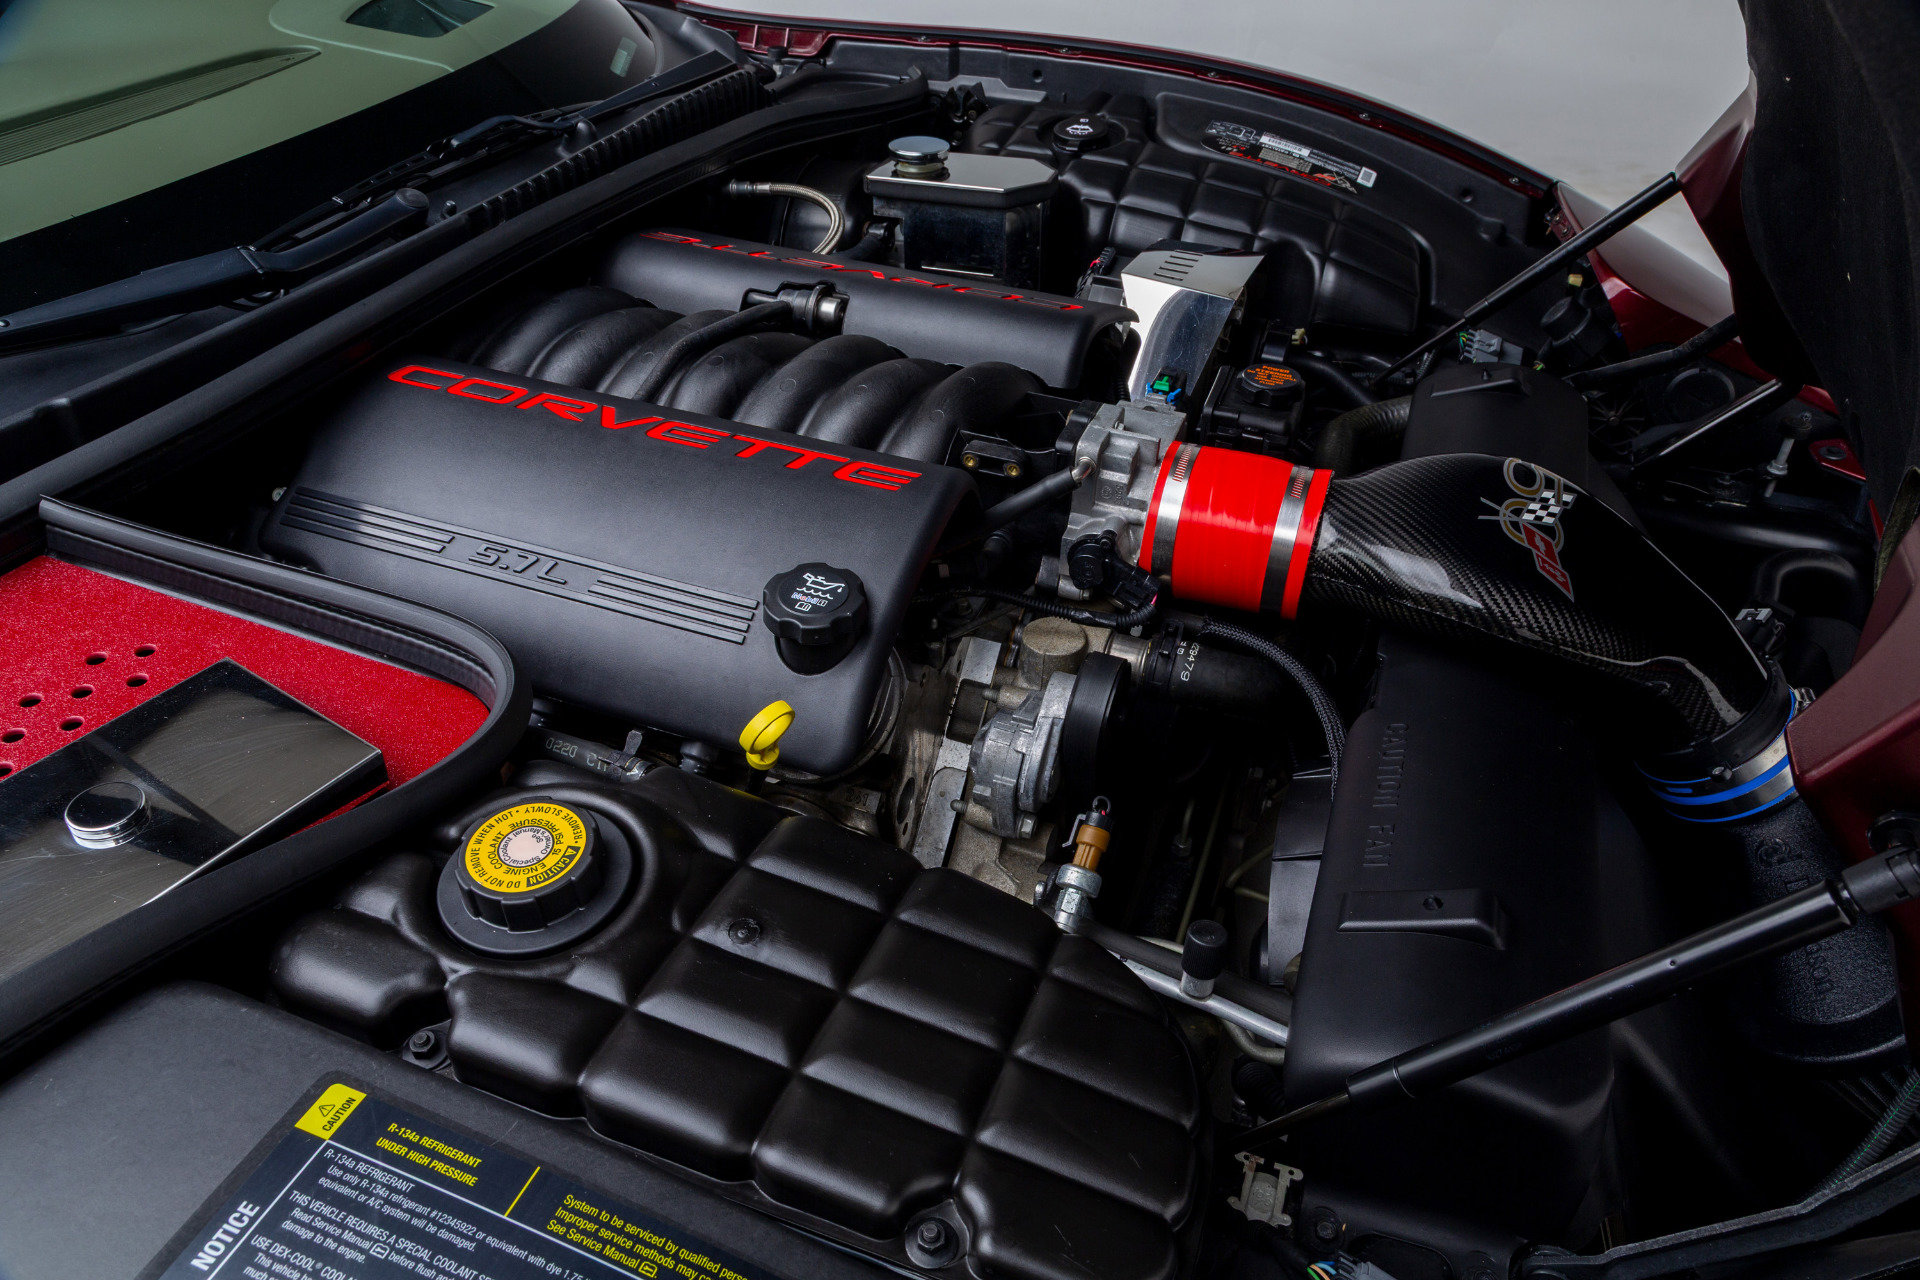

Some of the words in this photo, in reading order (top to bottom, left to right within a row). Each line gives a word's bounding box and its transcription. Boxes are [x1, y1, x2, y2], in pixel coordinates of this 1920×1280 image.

[387, 365, 922, 491] CORVETTE
[468, 544, 567, 585] 5.7L
[1373, 724, 1409, 807] CAUTION
[495, 810, 514, 825] HOT
[508, 818, 559, 833] PRESSURE
[525, 806, 562, 817] SLOWLY
[561, 812, 583, 841] REMOVE
[473, 822, 496, 846] WHEN
[488, 831, 505, 870] COOLANT
[500, 836, 512, 862] Coolant
[512, 826, 542, 837] Manual
[1363, 824, 1395, 866] FAN
[470, 847, 488, 879] REMOVE
[503, 862, 547, 876] ENGINE
[510, 856, 540, 866] Special
[529, 857, 570, 885] CAUTION
[484, 874, 505, 888] NOT
[507, 880, 521, 888] DO
[322, 1097, 356, 1131] CAUTION
[376, 1137, 408, 1157] UNDER
[406, 1150, 431, 1166] HIGH
[429, 1160, 479, 1187] PRESSURE
[387, 1122, 420, 1142] R-134a
[420, 1136, 482, 1168] REFRIGERANT
[324, 1148, 356, 1168] R-134a
[355, 1162, 415, 1193] REFRIGERANT
[319, 1177, 359, 1200] equivalent
[357, 1193, 368, 1202] or
[366, 1196, 384, 1209] A/C
[382, 1203, 411, 1222] system
[411, 1216, 427, 1229] will
[425, 1222, 438, 1234] be
[437, 1228, 476, 1252] damaged.
[327, 1165, 343, 1177] Use
[343, 1173, 361, 1186] only
[360, 1179, 390, 1198] R-134a
[389, 1192, 431, 1216] refrigerant
[430, 1209, 477, 1236] #12345922
[475, 1231, 486, 1240] or
[485, 1235, 528, 1260] equivalent
[527, 1253, 546, 1268] with
[546, 1262, 562, 1275] dye
[190, 1200, 260, 1271] NOTICE
[250, 1234, 273, 1250] USE
[281, 1219, 315, 1240] damage
[313, 1233, 324, 1244] to
[323, 1237, 338, 1250] the
[337, 1245, 366, 1264] engine.
[289, 1190, 311, 1207] THIS
[310, 1198, 347, 1222] VEHICLE
[344, 1215, 389, 1242] REQUIRES
[386, 1234, 397, 1246] A
[395, 1237, 432, 1262] SPECIAL
[433, 1255, 478, 1280] COOLANT
[291, 1207, 314, 1223] Read
[311, 1216, 343, 1237] Service
[341, 1229, 373, 1250] Manual
[388, 1251, 416, 1270] before
[414, 1265, 436, 1280] flush
[547, 1219, 565, 1235] See
[567, 1228, 603, 1252] Service
[602, 1245, 641, 1269] Manual
[555, 1207, 599, 1233] Improper
[598, 1227, 633, 1249] service
[633, 1243, 676, 1269] methods
[676, 1264, 698, 1280] may
[563, 1195, 599, 1217] System
[599, 1210, 610, 1222] to
[610, 1214, 624, 1228] be
[624, 1223, 667, 1247] serviced
[665, 1239, 679, 1255] by
[678, 1248, 721, 1274] qualified
[254, 1252, 273, 1268] This
